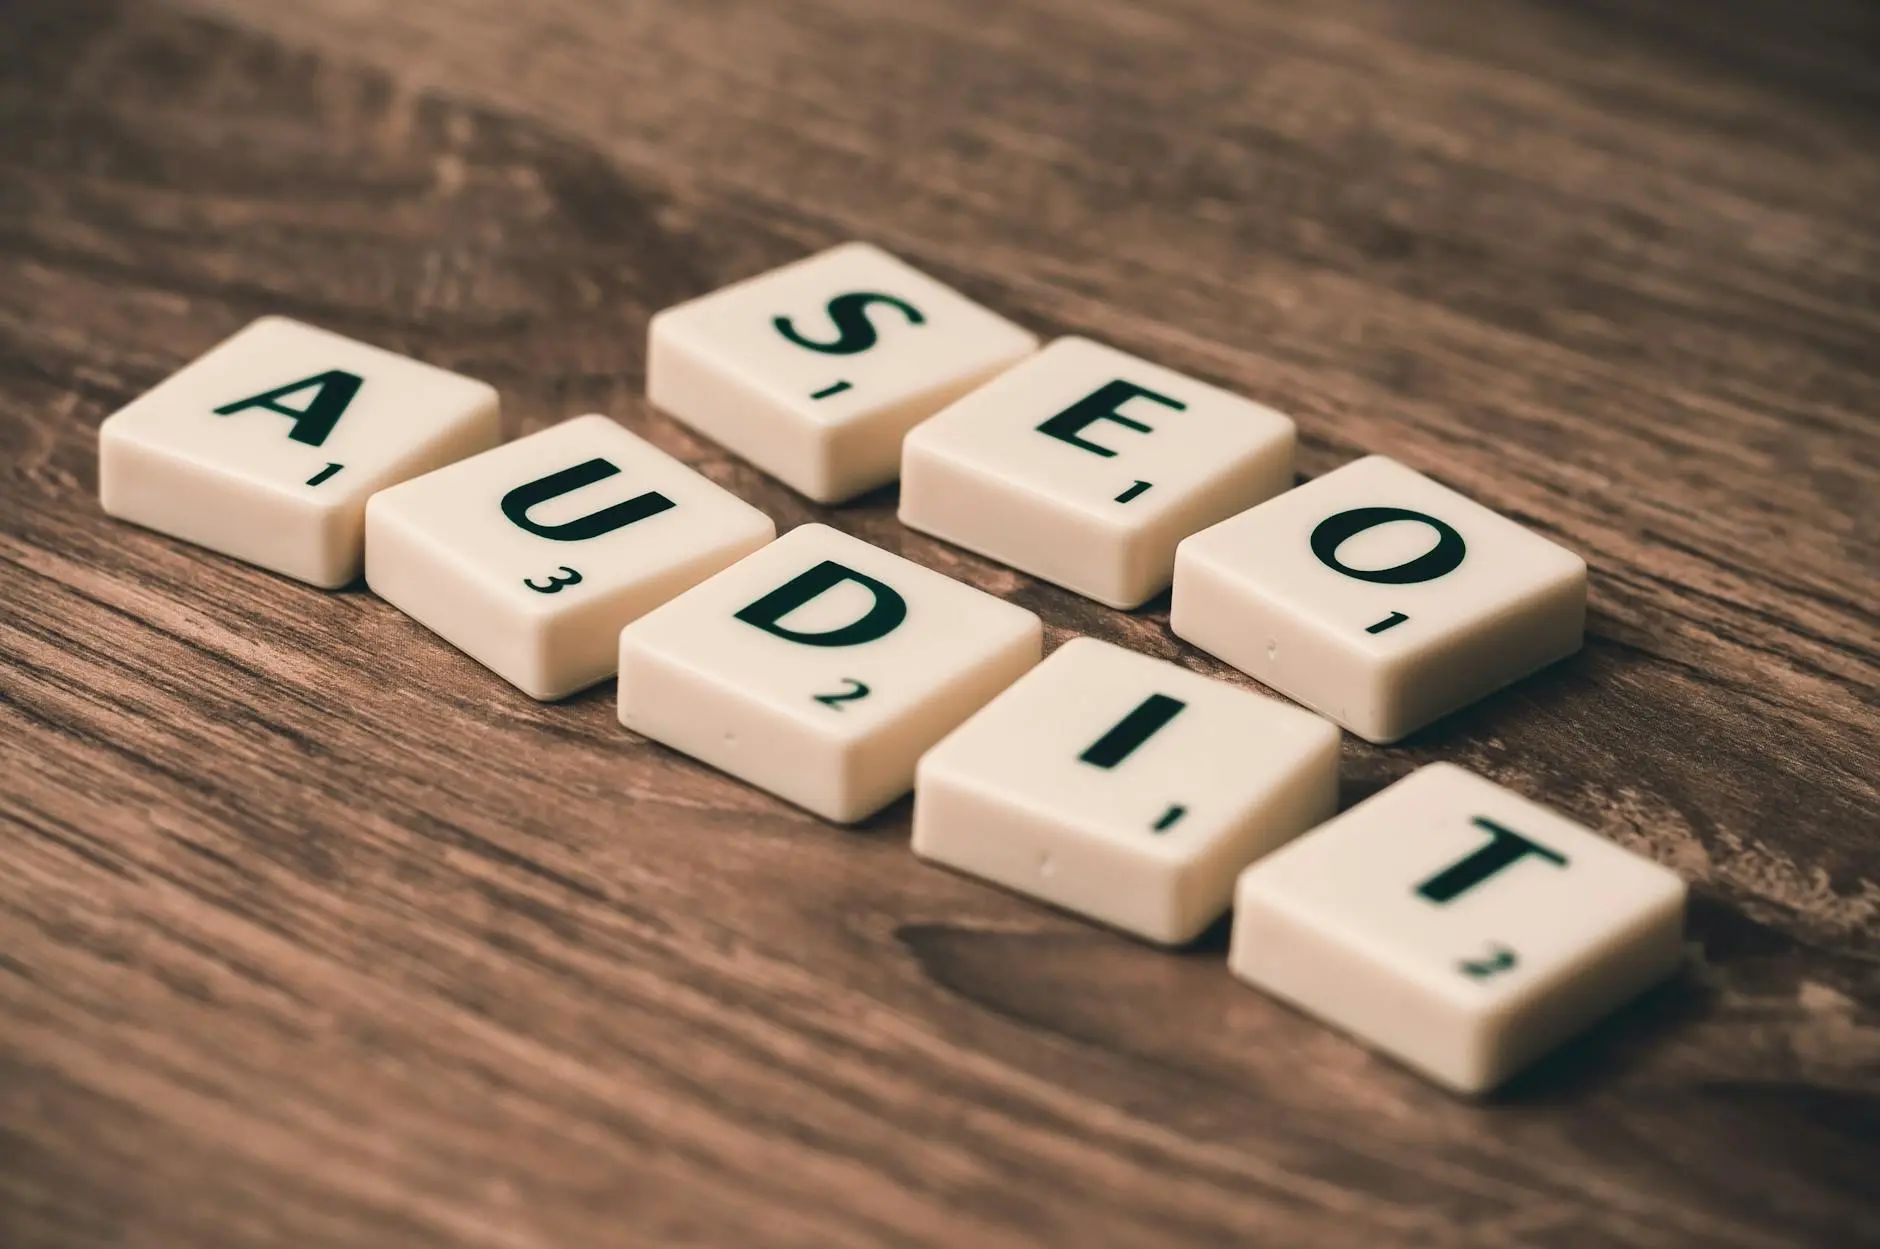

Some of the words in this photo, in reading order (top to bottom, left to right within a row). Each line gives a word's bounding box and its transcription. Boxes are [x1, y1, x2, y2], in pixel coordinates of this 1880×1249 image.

[810, 381, 852, 400] 1
[305, 462, 345, 487] 1
[1113, 479, 1153, 504] 1
[522, 565, 583, 594] 3
[1365, 610, 1410, 635] 1
[812, 677, 871, 710] 2
[1153, 804, 1187, 833] 1
